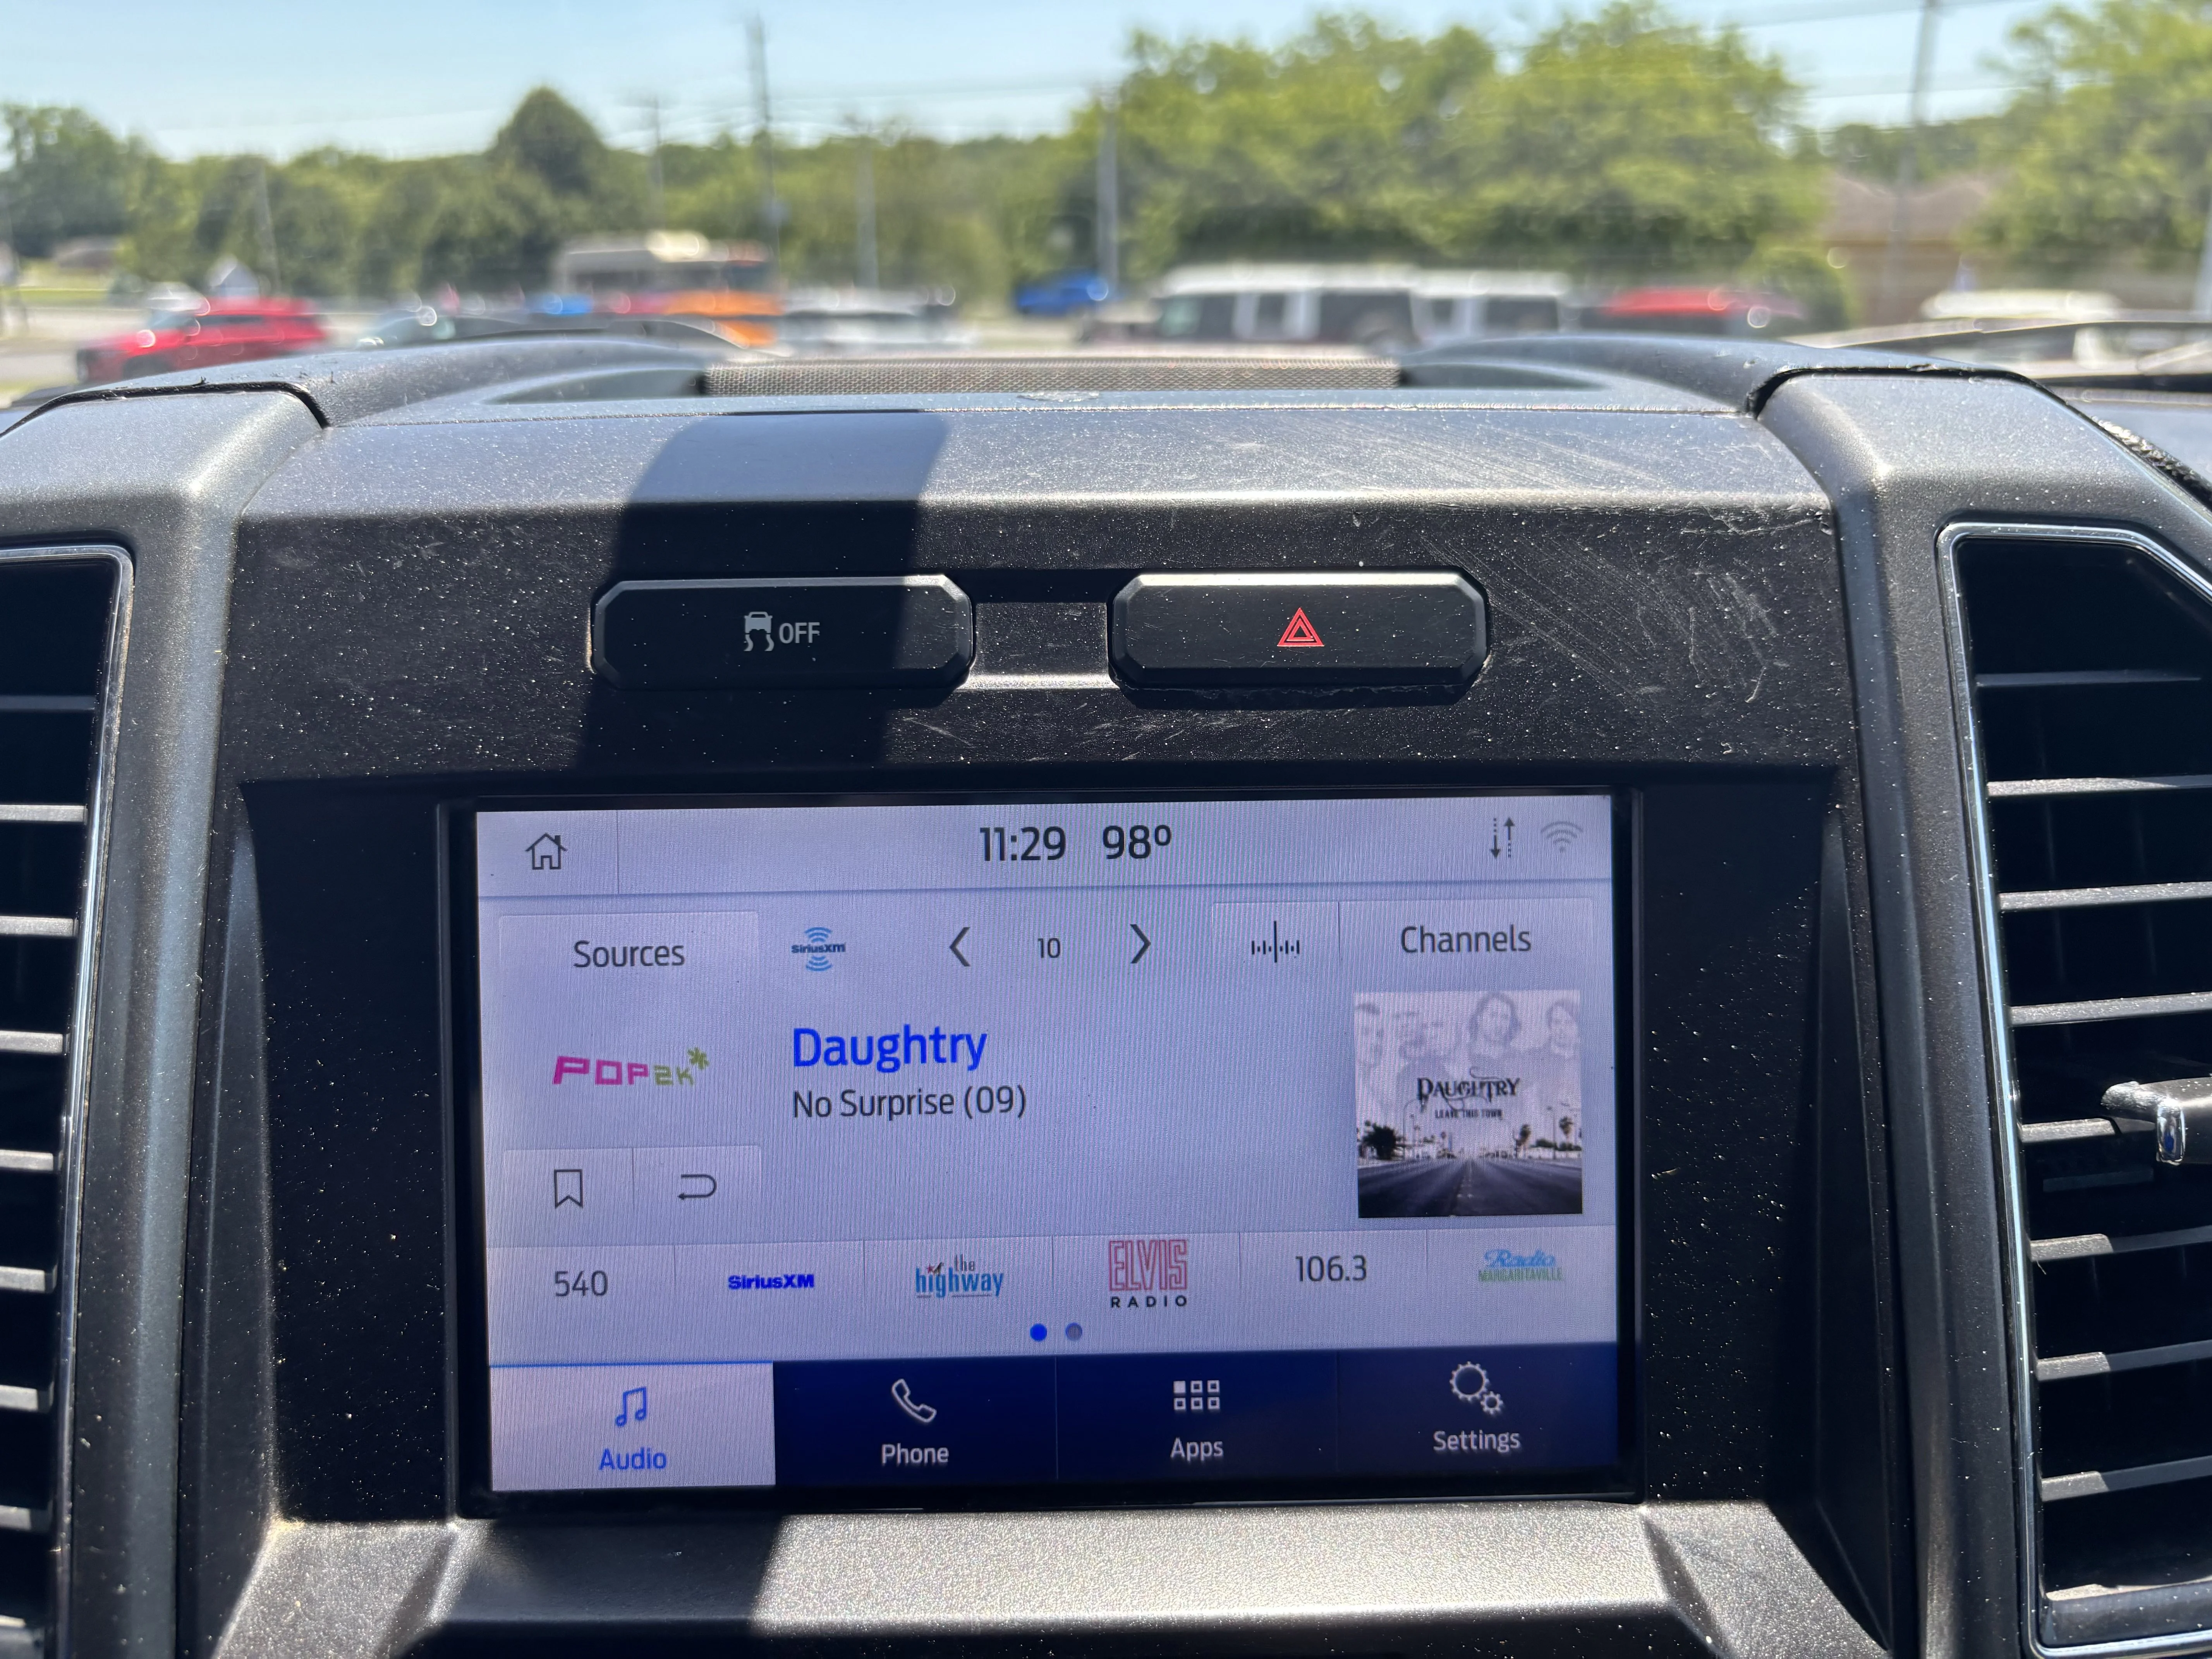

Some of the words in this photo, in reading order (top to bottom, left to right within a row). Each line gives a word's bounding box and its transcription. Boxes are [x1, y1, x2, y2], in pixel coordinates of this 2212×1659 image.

[779, 622, 820, 644] OFF
[980, 826, 1066, 861] 11:29
[1037, 938, 1061, 958] 10
[1400, 924, 1532, 953] Channels
[574, 940, 685, 968] Sources
[793, 1024, 988, 1073] Daughtry
[794, 1090, 832, 1118] No
[840, 1088, 955, 1121] Surprise
[964, 1084, 1027, 1119] (09)
[954, 1254, 975, 1271] the
[1108, 1238, 1188, 1291] ELVIS
[1295, 1255, 1367, 1283] 106.3
[555, 1269, 608, 1297] 540
[728, 1274, 814, 1290] SiriusXM
[915, 1267, 1004, 1298] highway
[1111, 1295, 1187, 1308] RADIO
[1170, 1437, 1224, 1462] Apps
[1433, 1429, 1521, 1453] Settings
[599, 1447, 667, 1471] Audio
[881, 1443, 950, 1466] Phone
